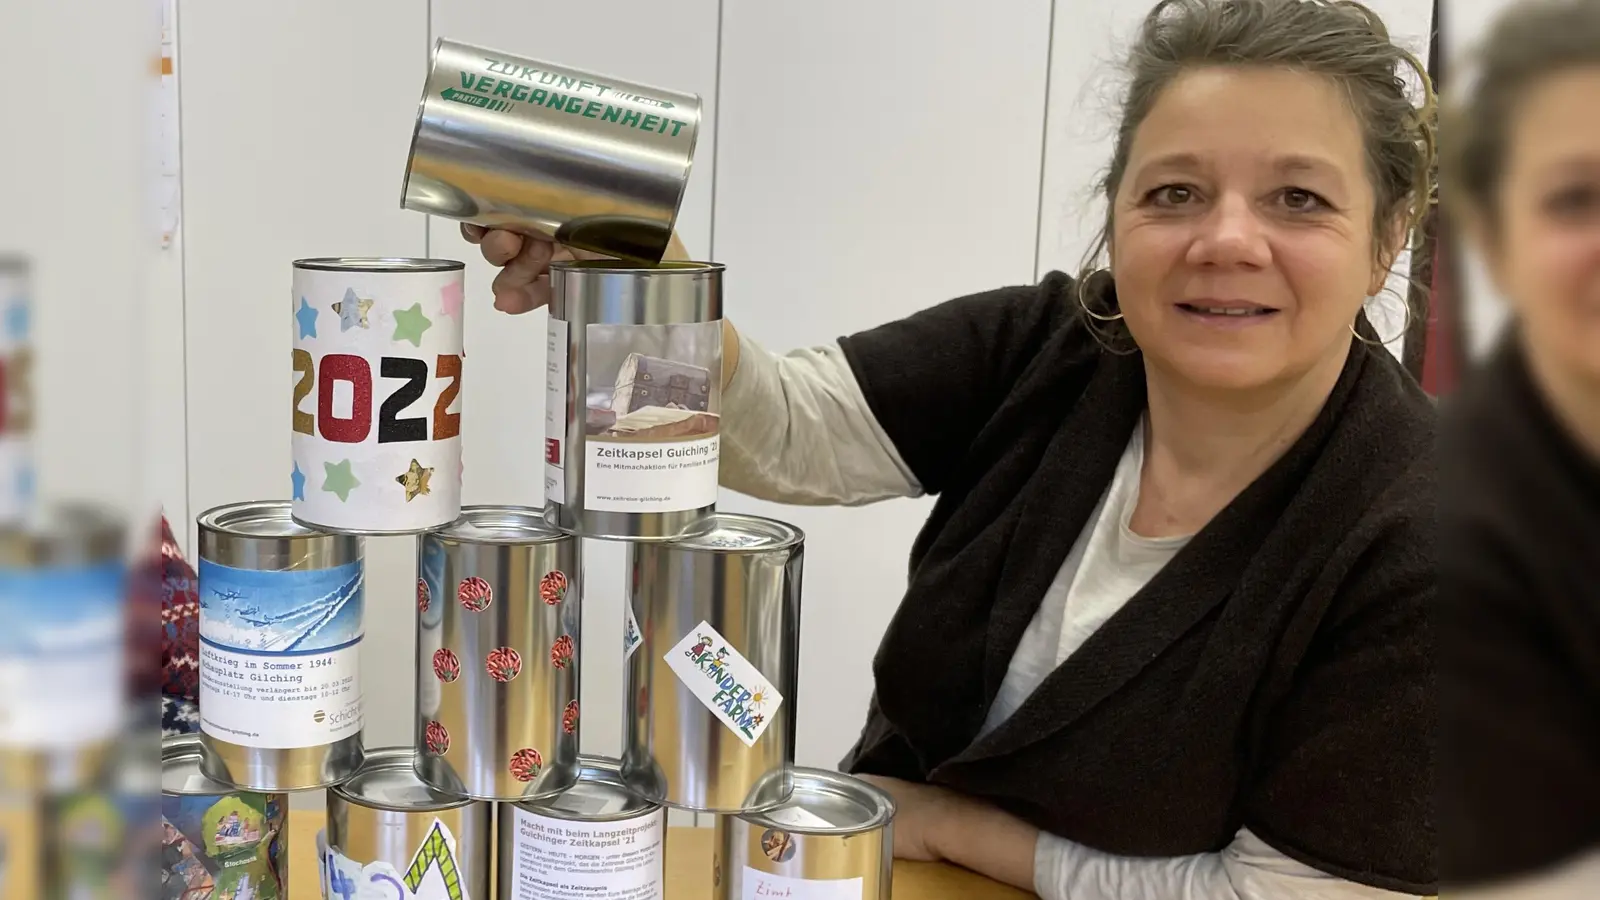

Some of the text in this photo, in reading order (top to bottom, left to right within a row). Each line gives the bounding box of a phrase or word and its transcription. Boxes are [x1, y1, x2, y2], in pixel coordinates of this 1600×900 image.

[484, 57, 613, 97] ZUKUNFT
[452, 92, 484, 105] PARTIE
[460, 71, 688, 136] VERGANGENHEIT
[292, 348, 462, 444] 2022
[596, 447, 663, 460] Zeitkapsel
[666, 444, 709, 458] Guiching
[596, 462, 612, 470] Eine
[613, 462, 666, 471] Mitmachaktion
[668, 461, 678, 470] für
[244, 659, 257, 669] im
[262, 661, 302, 671] Sommer
[309, 657, 337, 669] 1944:
[249, 673, 303, 684] Gilching
[243, 693, 257, 701] Uhr
[277, 693, 317, 702] dienstags
[256, 686, 301, 695] verlängert
[304, 685, 317, 693] bis
[520, 818, 545, 833] Macht
[547, 824, 563, 837] mit
[565, 828, 590, 839] beim
[520, 827, 636, 849] Guichinger Zeitkapsel '21
[548, 851, 567, 859] HEUTE
[755, 880, 793, 898] Zimt
